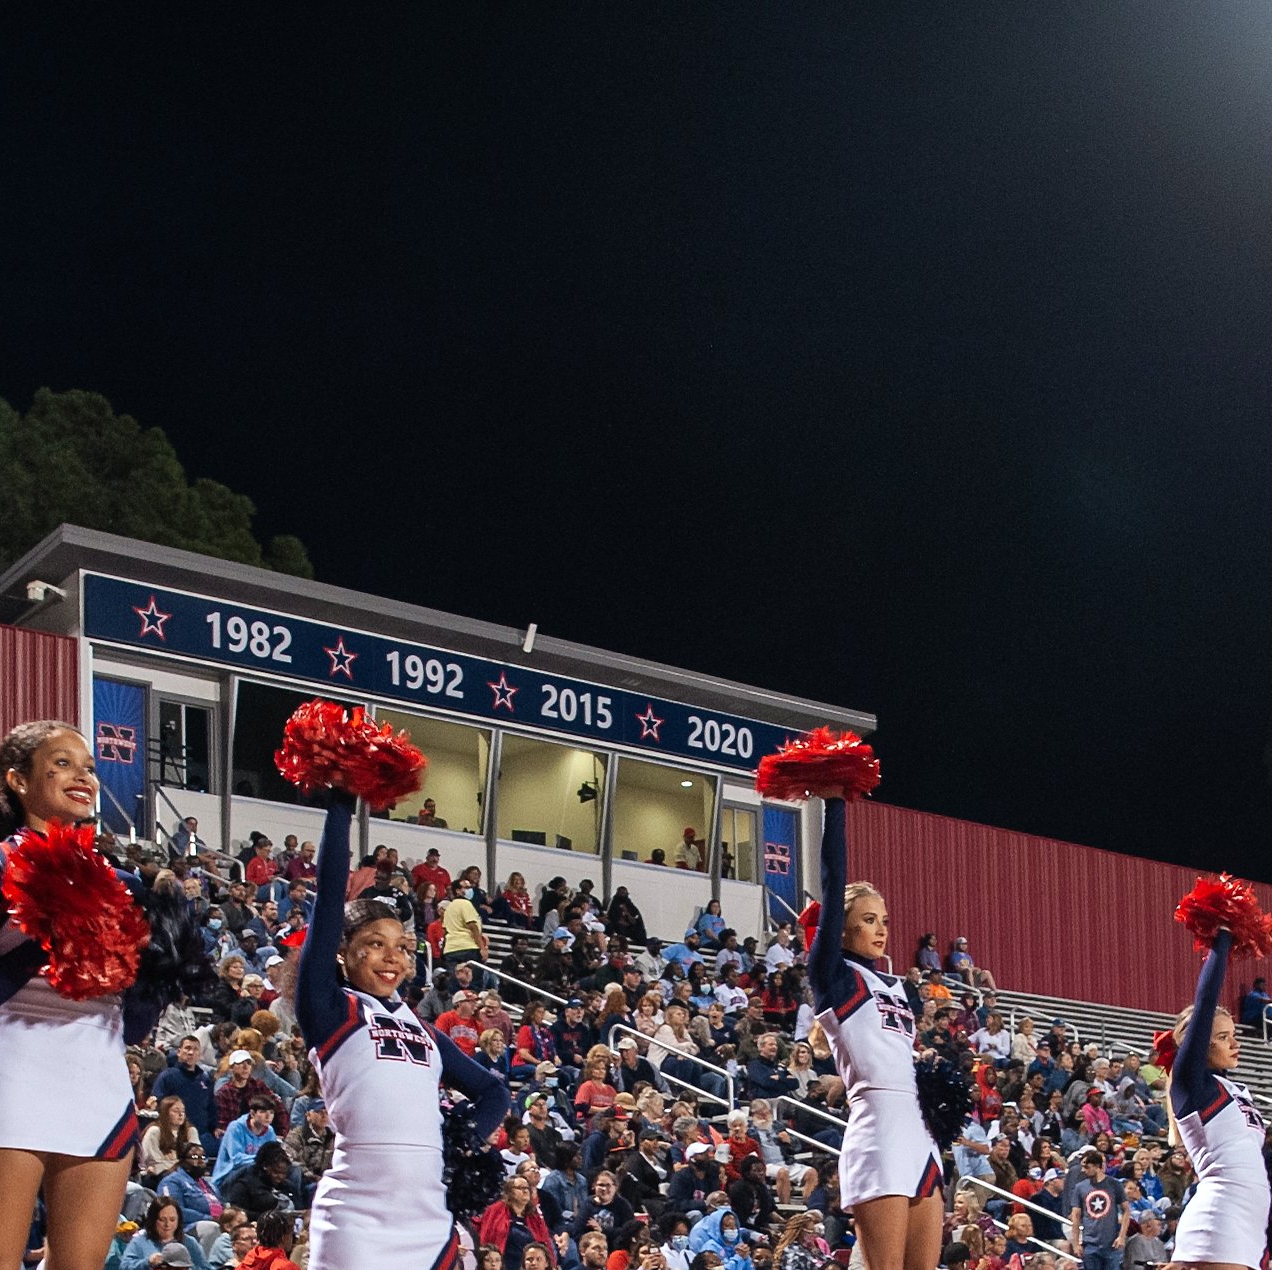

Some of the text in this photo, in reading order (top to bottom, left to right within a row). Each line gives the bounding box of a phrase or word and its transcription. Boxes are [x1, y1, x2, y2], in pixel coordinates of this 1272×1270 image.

[206, 611, 753, 759] 1982 1992 2015 2020
[98, 722, 134, 765] N
[371, 1028, 433, 1050] NORTHWEST
[371, 1012, 432, 1067] N
